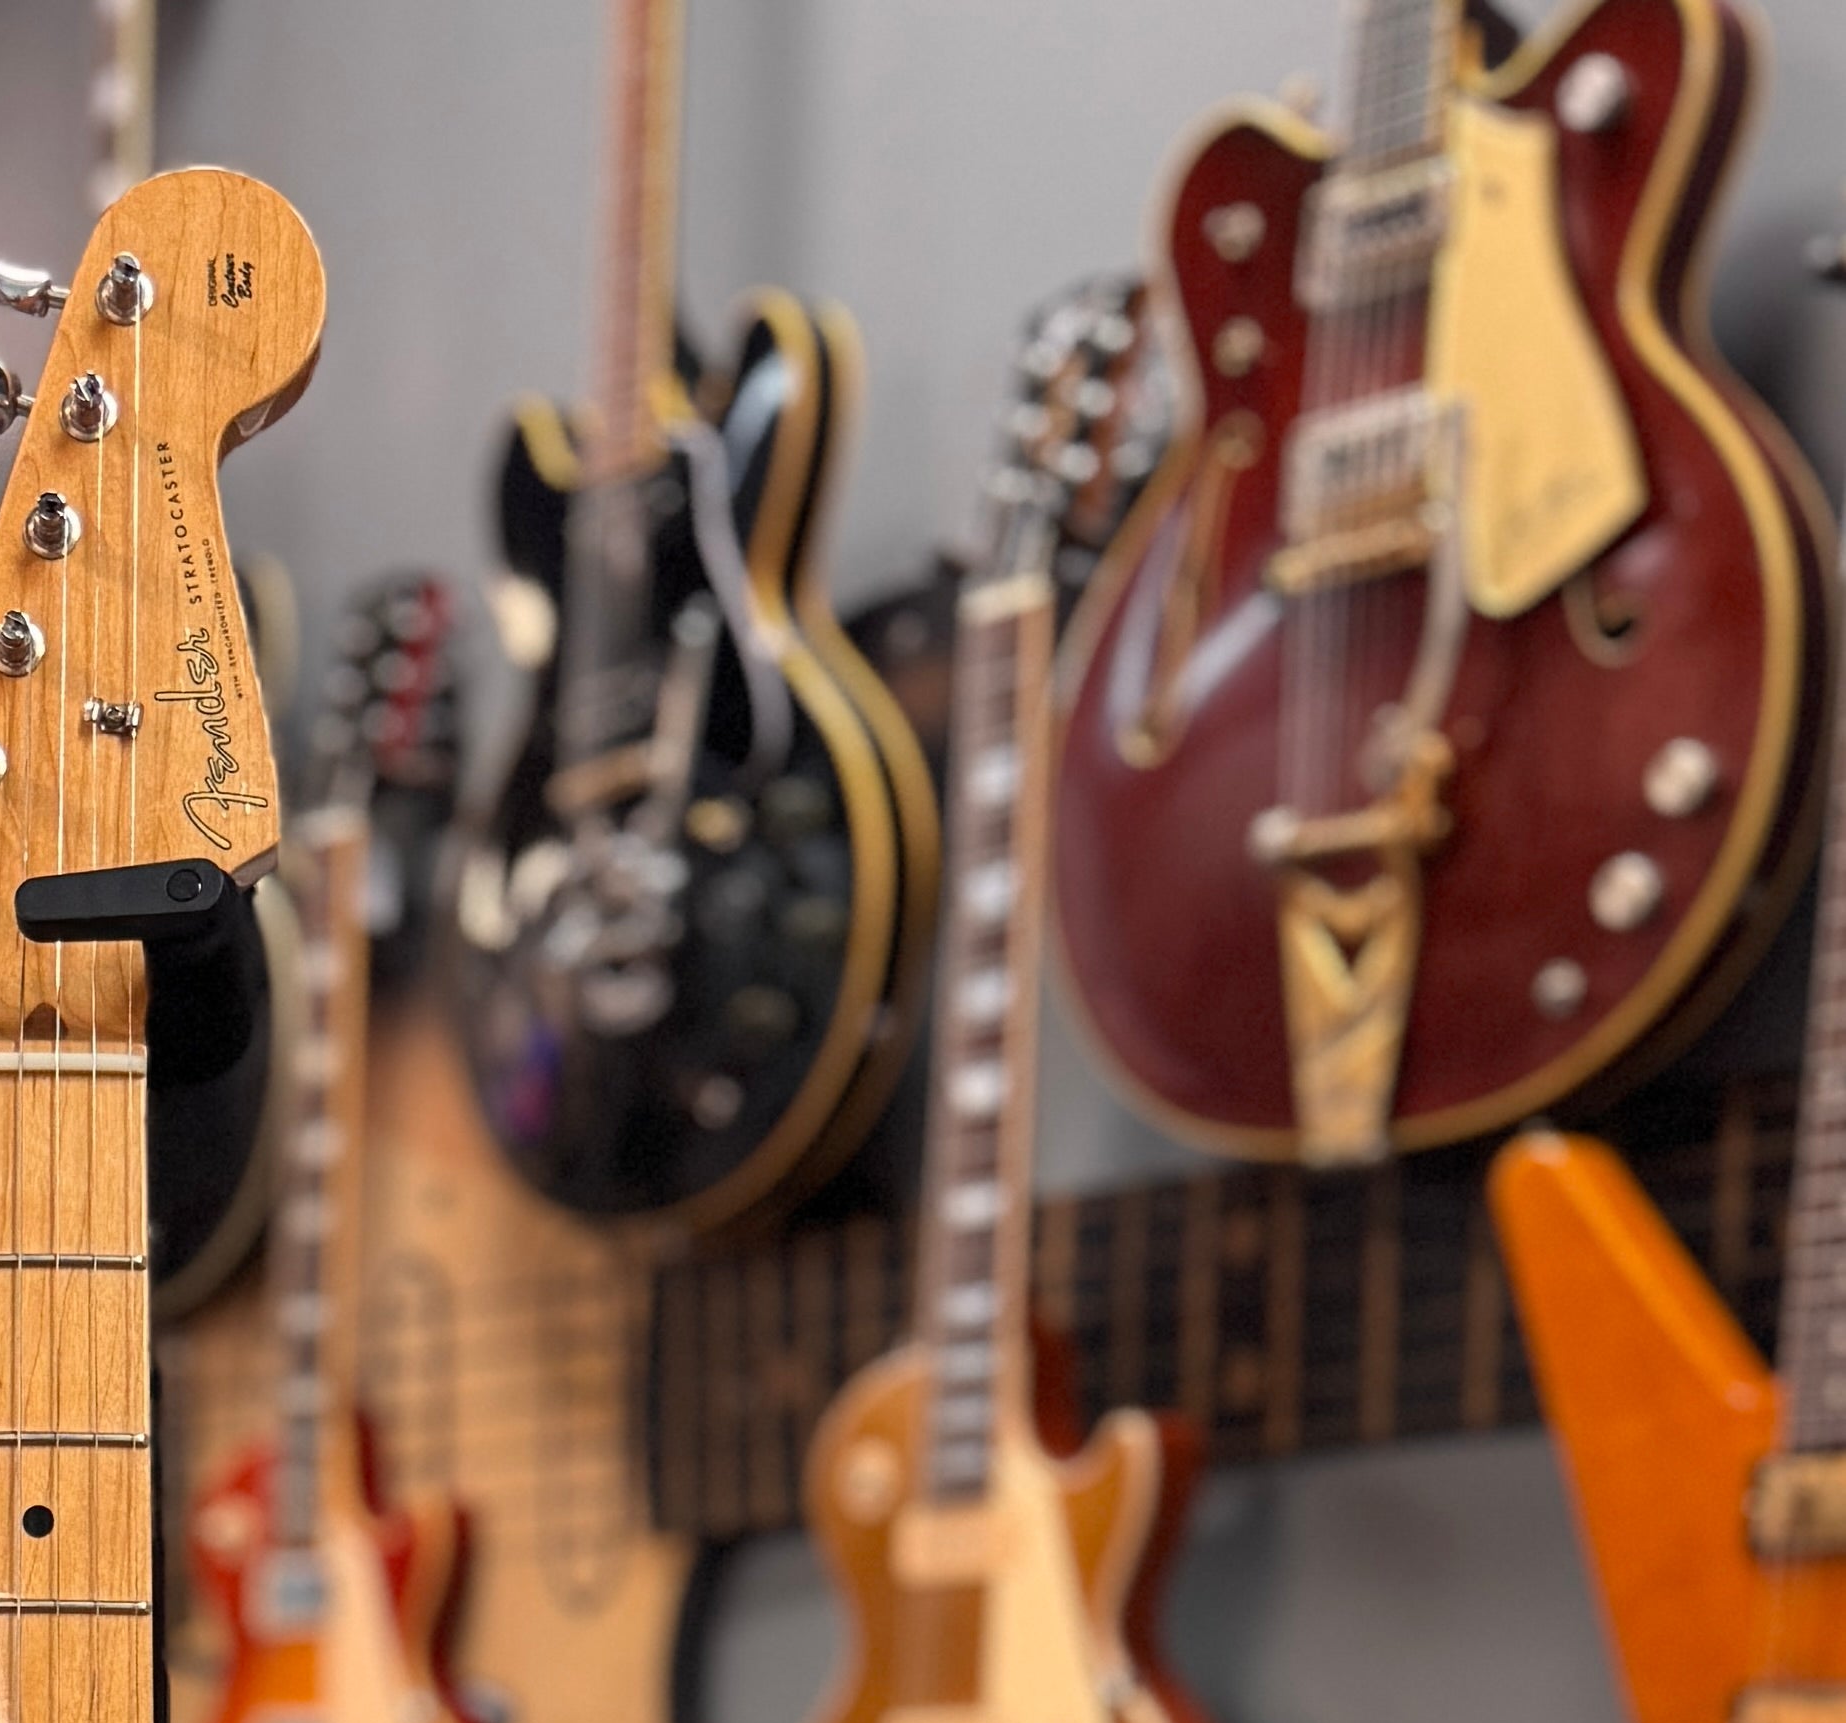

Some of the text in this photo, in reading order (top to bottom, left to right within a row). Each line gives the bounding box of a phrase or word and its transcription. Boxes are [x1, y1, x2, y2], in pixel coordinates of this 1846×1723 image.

[237, 261, 255, 299] Body
[157, 441, 202, 605] STRATOCASTER
[154, 627, 269, 851] Fender
